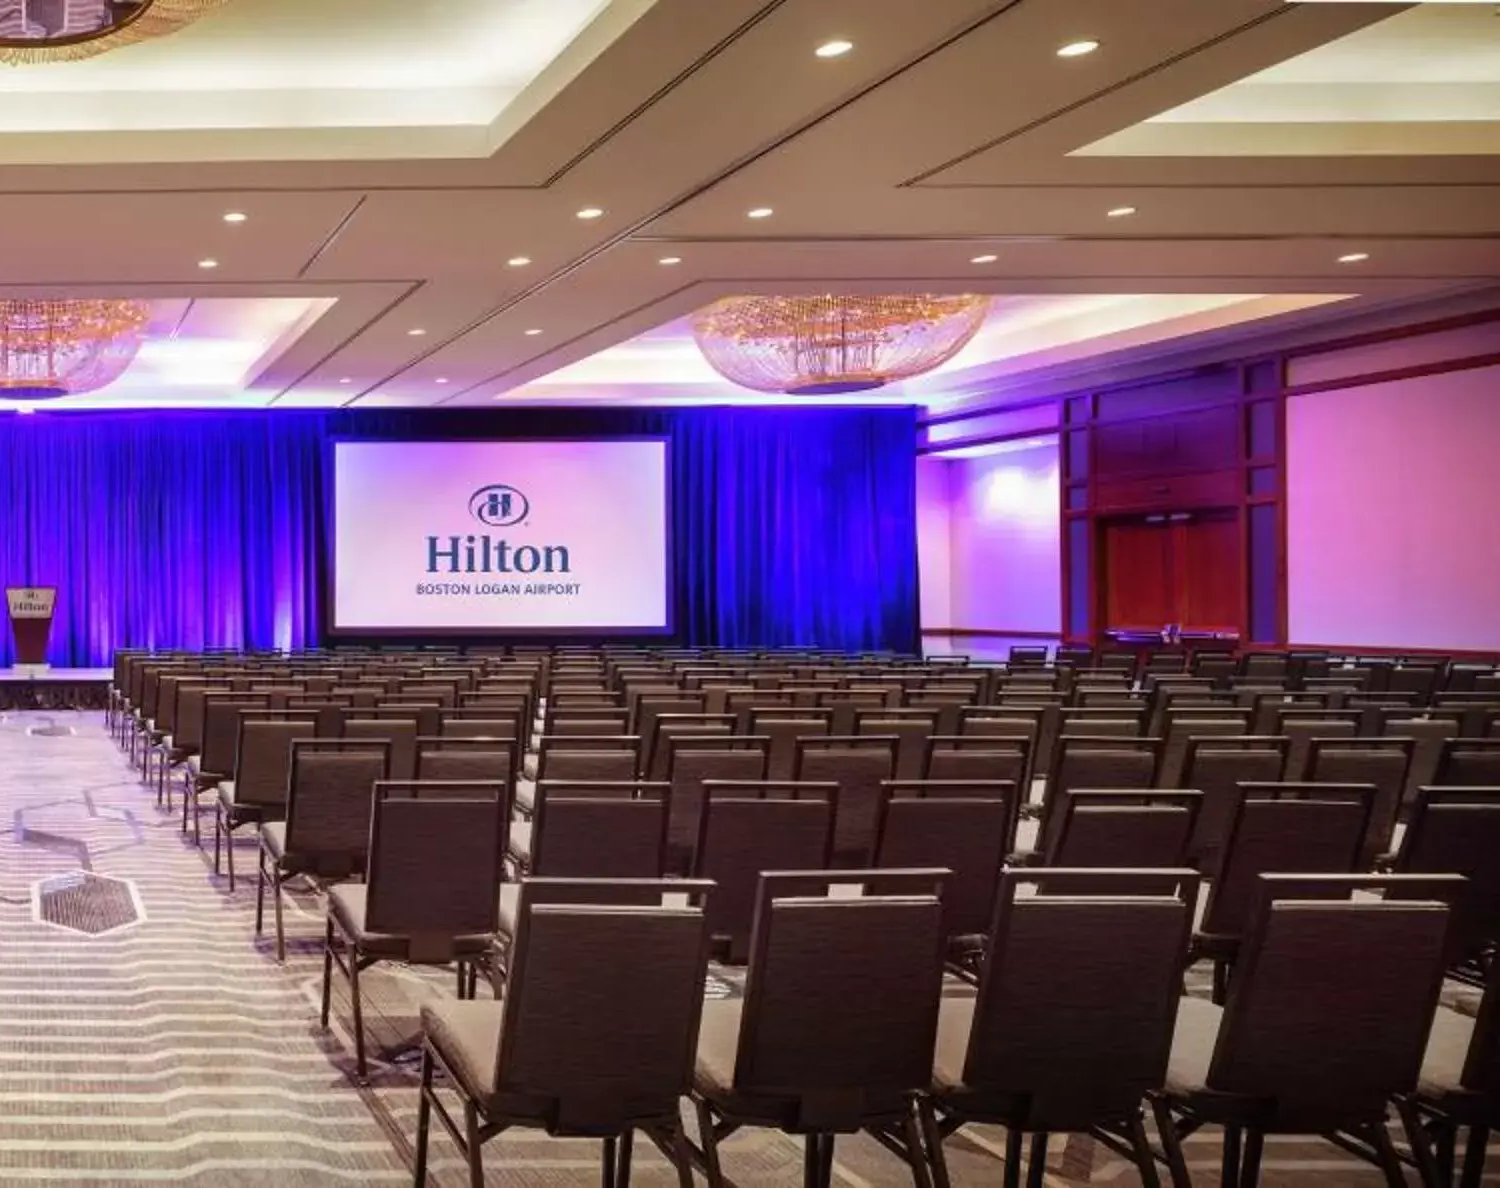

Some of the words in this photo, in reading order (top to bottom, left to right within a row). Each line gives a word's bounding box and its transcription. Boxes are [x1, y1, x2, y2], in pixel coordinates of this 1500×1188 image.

[425, 535, 572, 573] Hilton
[416, 583, 470, 595] BOSTON
[475, 583, 520, 595] LOGAN
[524, 583, 580, 595] AIRPORT
